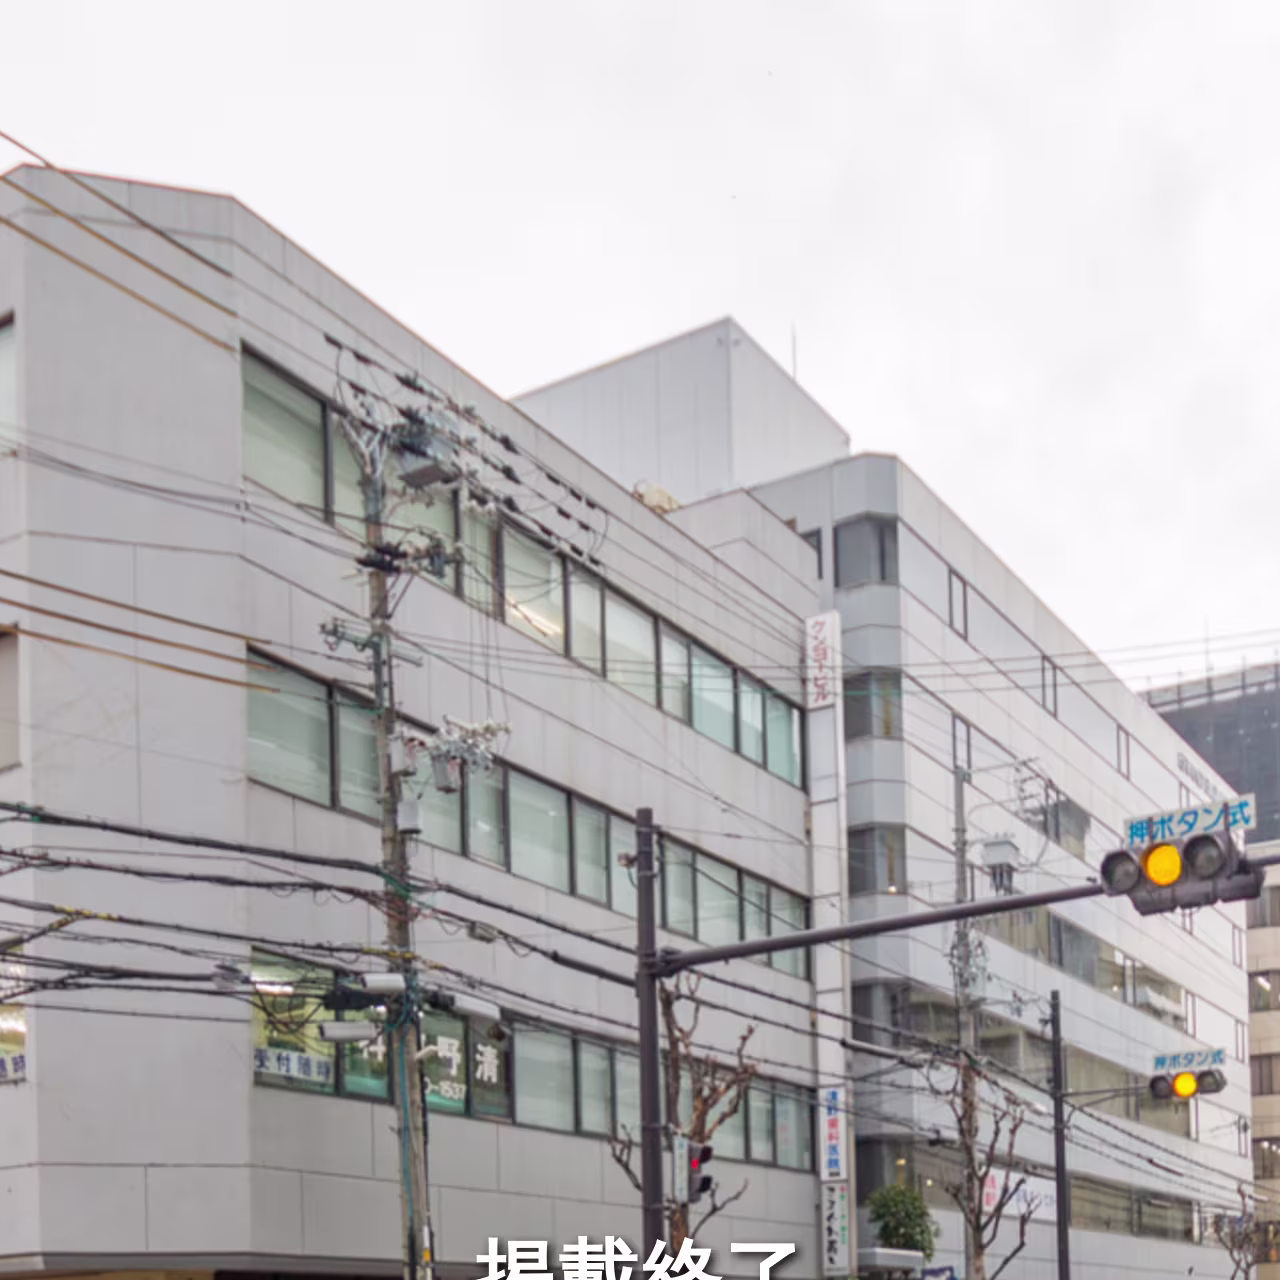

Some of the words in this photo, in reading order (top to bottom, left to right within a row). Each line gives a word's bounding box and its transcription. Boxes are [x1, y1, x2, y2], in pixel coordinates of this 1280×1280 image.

[811, 619, 829, 704] ケンヨービル
[1128, 799, 1251, 845] 押ボタン式
[1153, 1049, 1225, 1071] 押ボタン式
